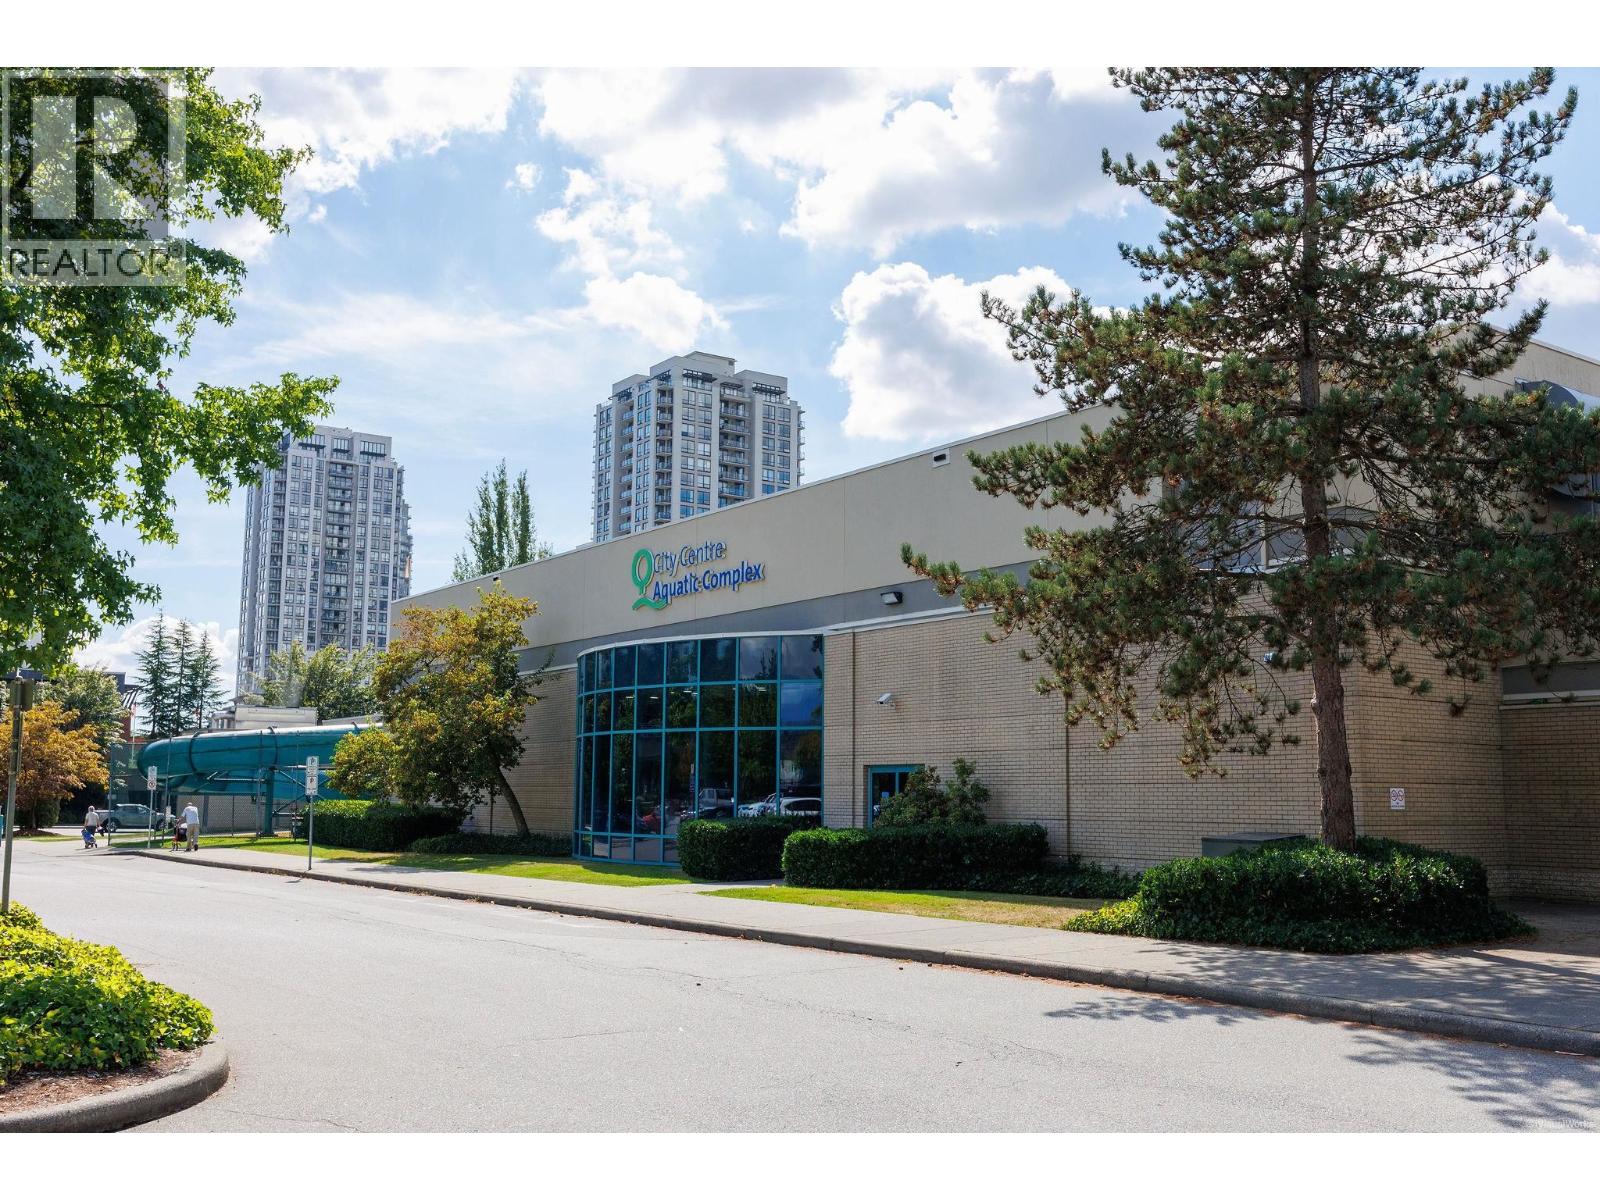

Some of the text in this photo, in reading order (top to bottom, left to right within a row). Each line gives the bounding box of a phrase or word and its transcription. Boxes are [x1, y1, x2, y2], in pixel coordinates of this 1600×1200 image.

[653, 541, 727, 577] City Centre
[652, 560, 763, 603] Aquatic Complex
